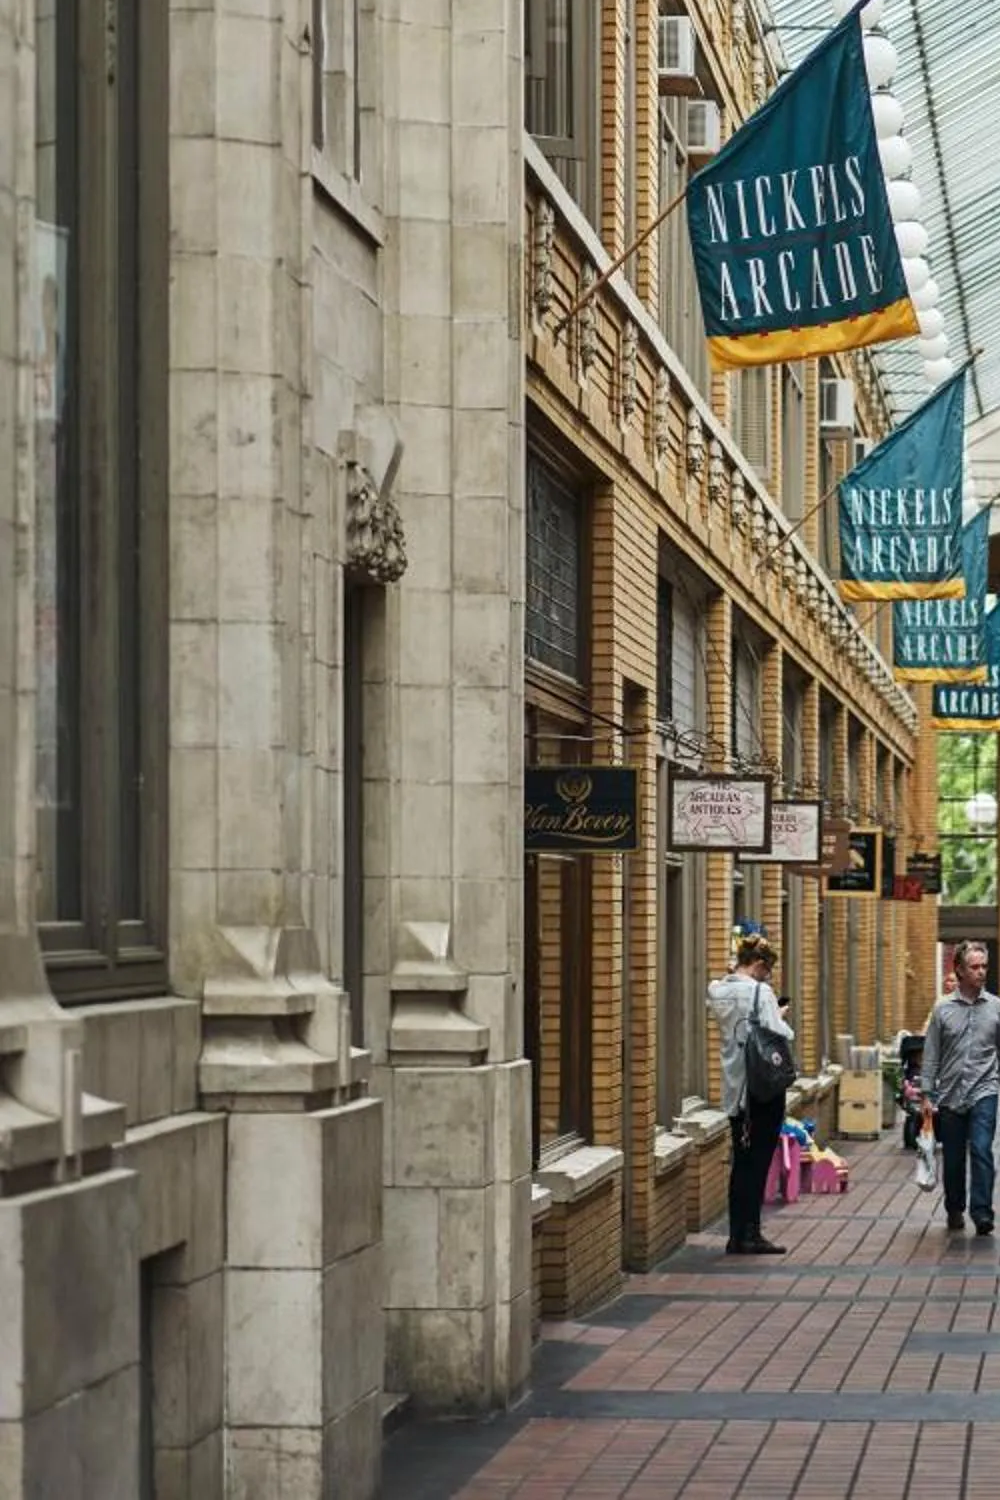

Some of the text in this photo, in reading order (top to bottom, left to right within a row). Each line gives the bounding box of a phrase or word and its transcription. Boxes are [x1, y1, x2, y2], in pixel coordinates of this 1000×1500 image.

[705, 156, 865, 243] NICKELS
[720, 235, 883, 321] ARCADE
[851, 488, 953, 525] NICKELS
[851, 535, 953, 573] ARCADE
[903, 599, 978, 627] NICKELS
[902, 633, 979, 661] ARCADE
[939, 690, 1000, 715] ARCADE
